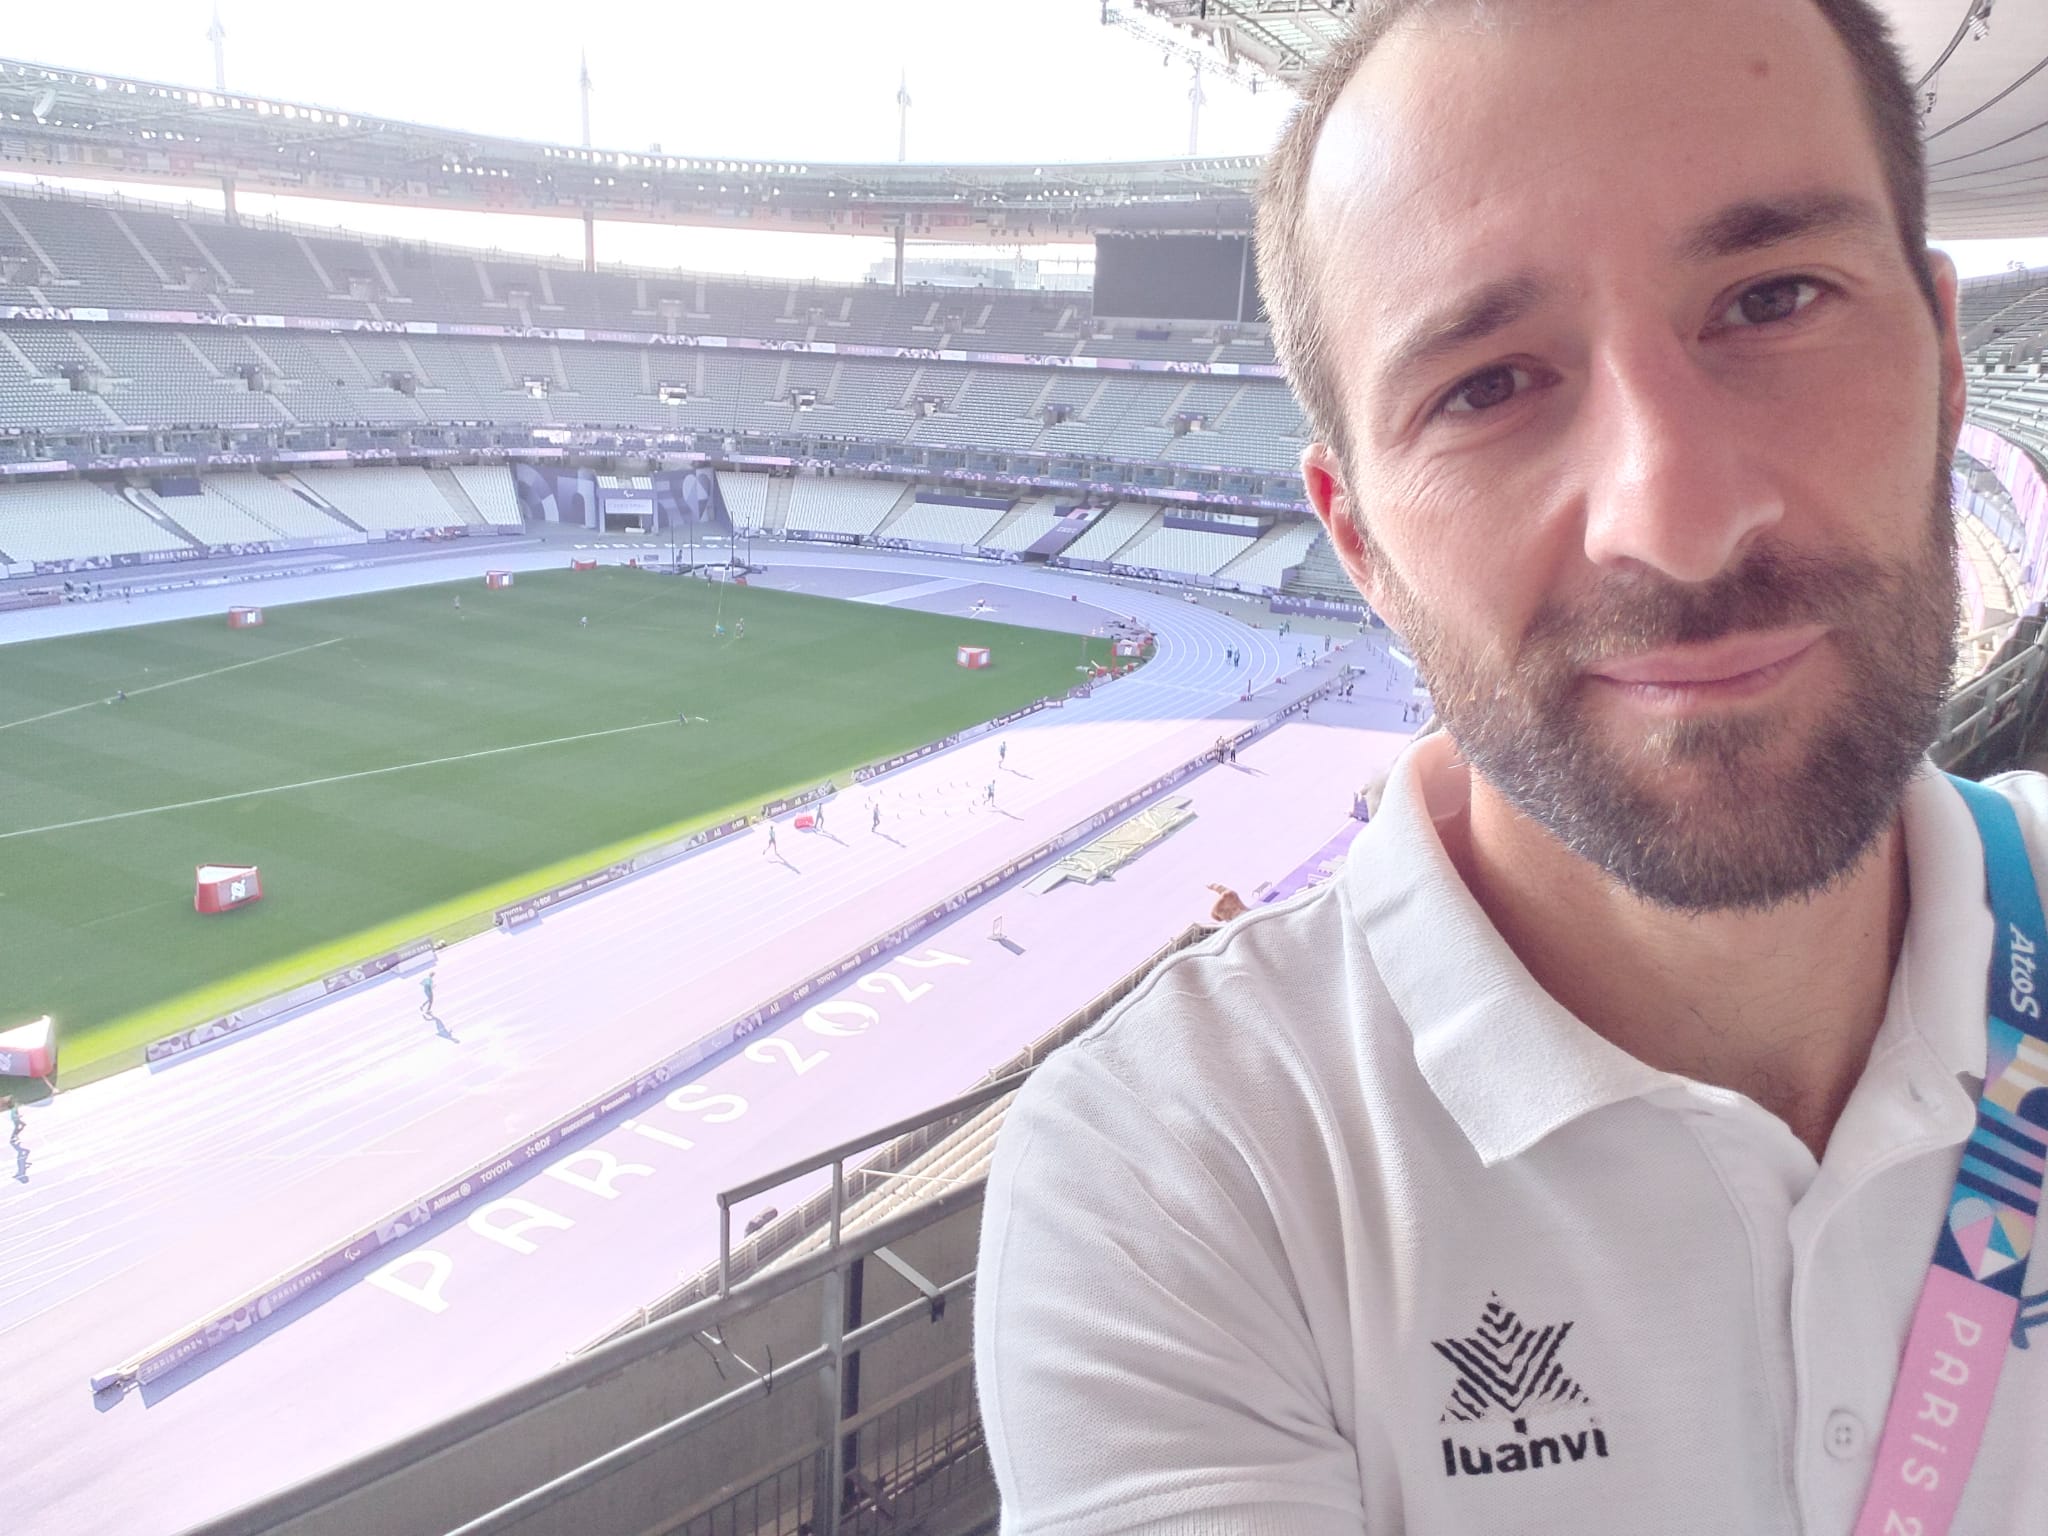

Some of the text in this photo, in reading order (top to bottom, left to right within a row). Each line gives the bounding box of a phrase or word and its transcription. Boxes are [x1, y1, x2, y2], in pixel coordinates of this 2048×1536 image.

[2009, 921, 2040, 1019] Atos
[744, 949, 972, 1077] 2024
[479, 1159, 513, 1184] TOYOTA
[433, 1189, 461, 1211] Allianz
[1441, 1424, 1609, 1477] luanvi
